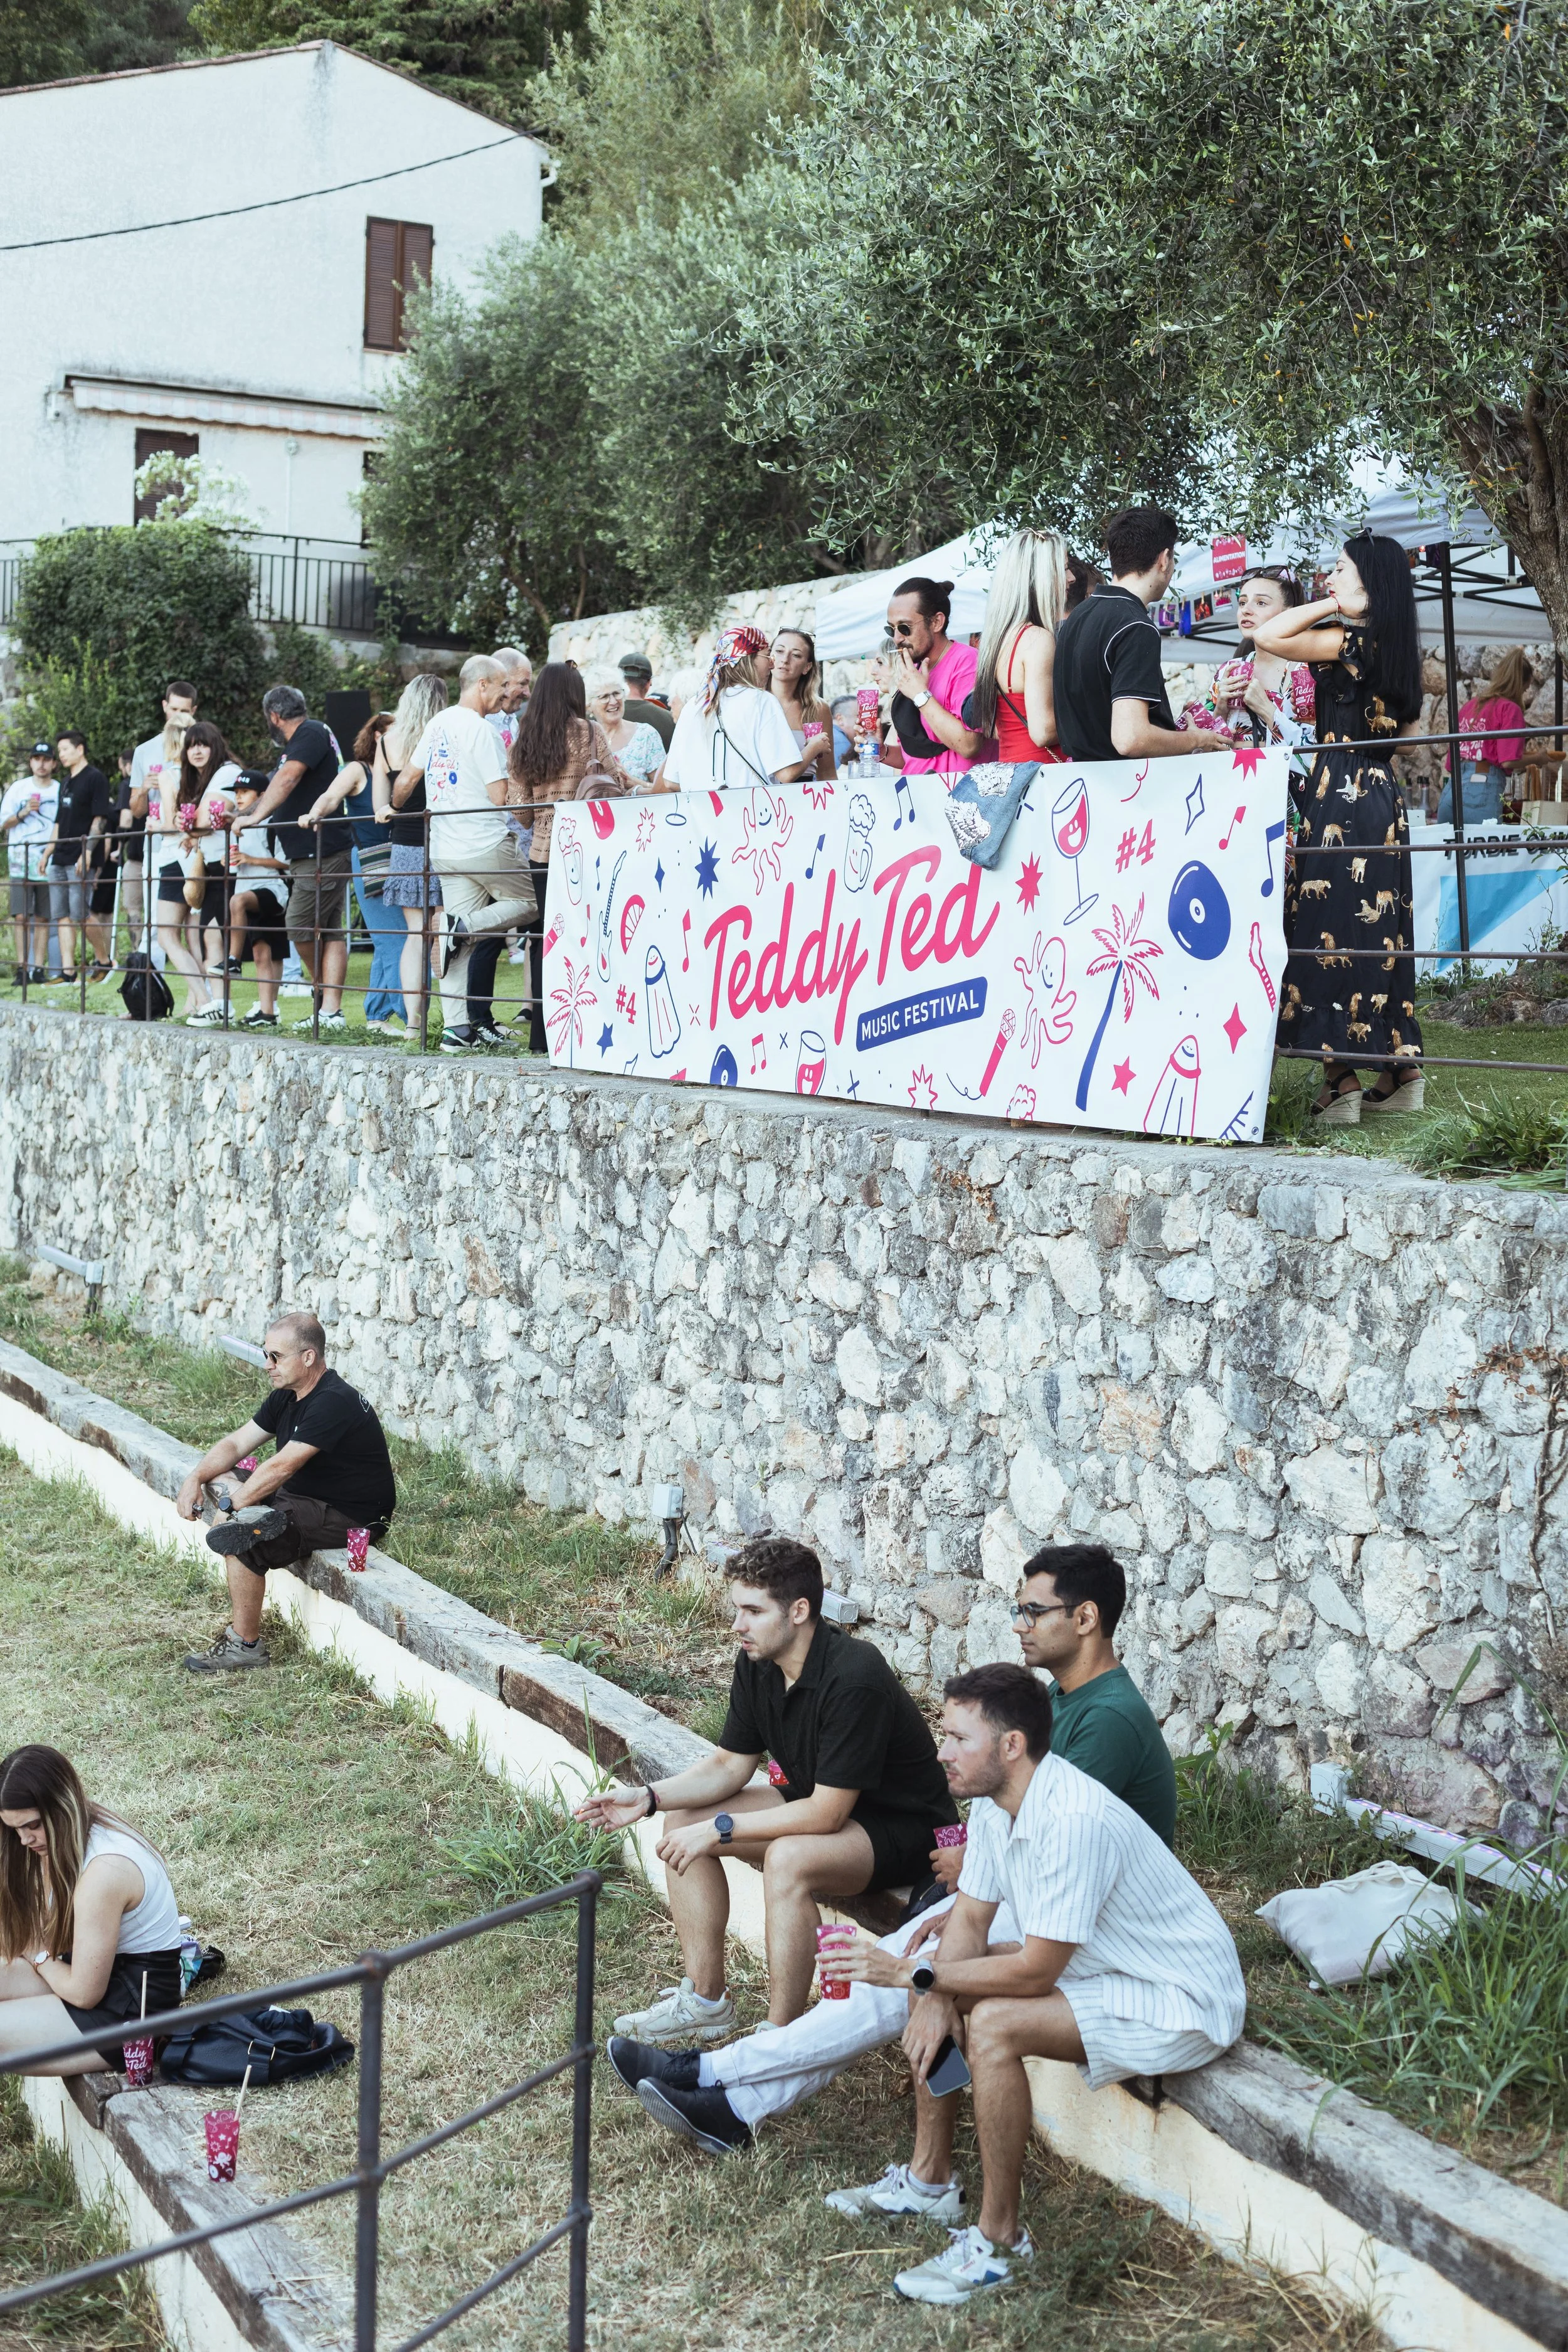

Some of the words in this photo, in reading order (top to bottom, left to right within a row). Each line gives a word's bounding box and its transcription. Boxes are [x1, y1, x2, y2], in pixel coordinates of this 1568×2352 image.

[1213, 551, 1246, 564] ALIMENTATION
[1295, 684, 1315, 696] Tedd
[1306, 694, 1315, 704] Te
[1115, 818, 1156, 874] #4
[704, 868, 869, 1046] Teddy
[873, 845, 1000, 986] Ted
[616, 983, 637, 1025] #4
[861, 1011, 900, 1041] MUSIC
[904, 989, 979, 1027] FESTIVAL
[129, 2057, 147, 2070] Ted
